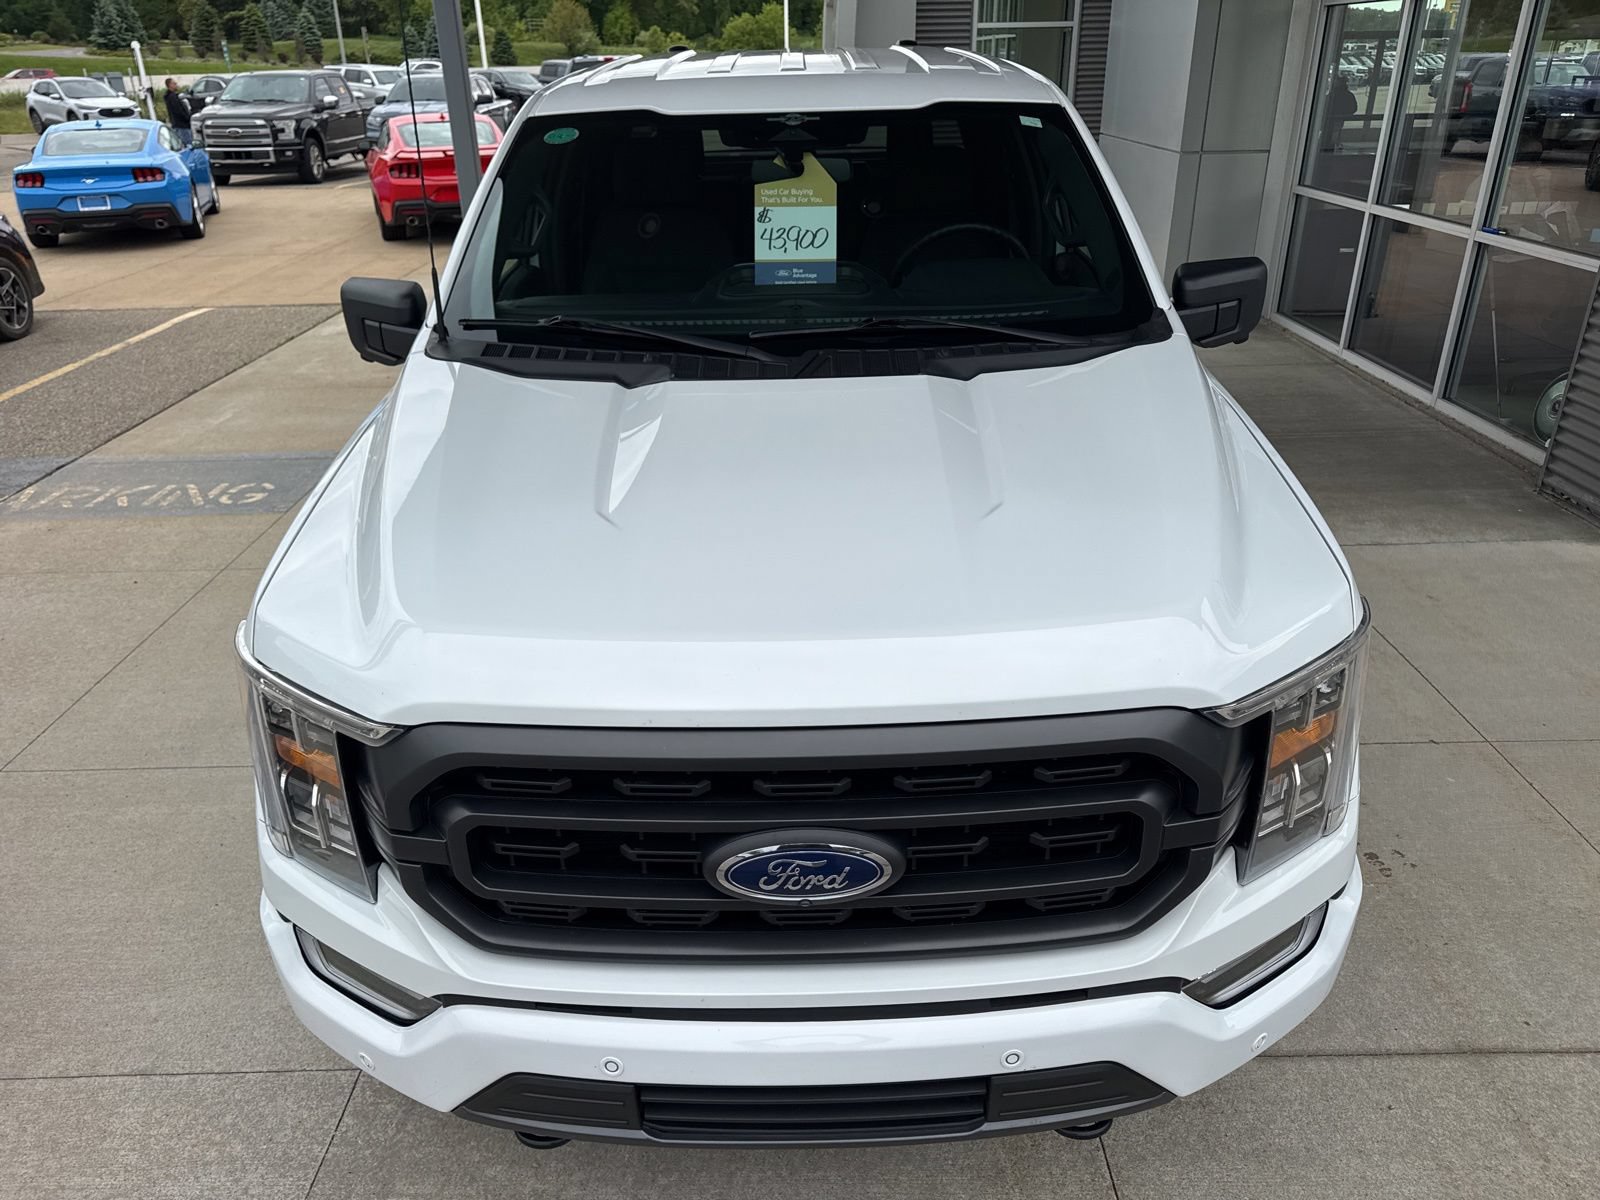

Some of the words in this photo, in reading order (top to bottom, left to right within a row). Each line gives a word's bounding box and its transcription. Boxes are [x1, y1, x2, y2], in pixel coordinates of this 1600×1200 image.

[791, 188, 813, 196] Buying
[757, 207, 773, 223] $
[760, 225, 829, 253] 43,900
[758, 858, 851, 891] Ford
